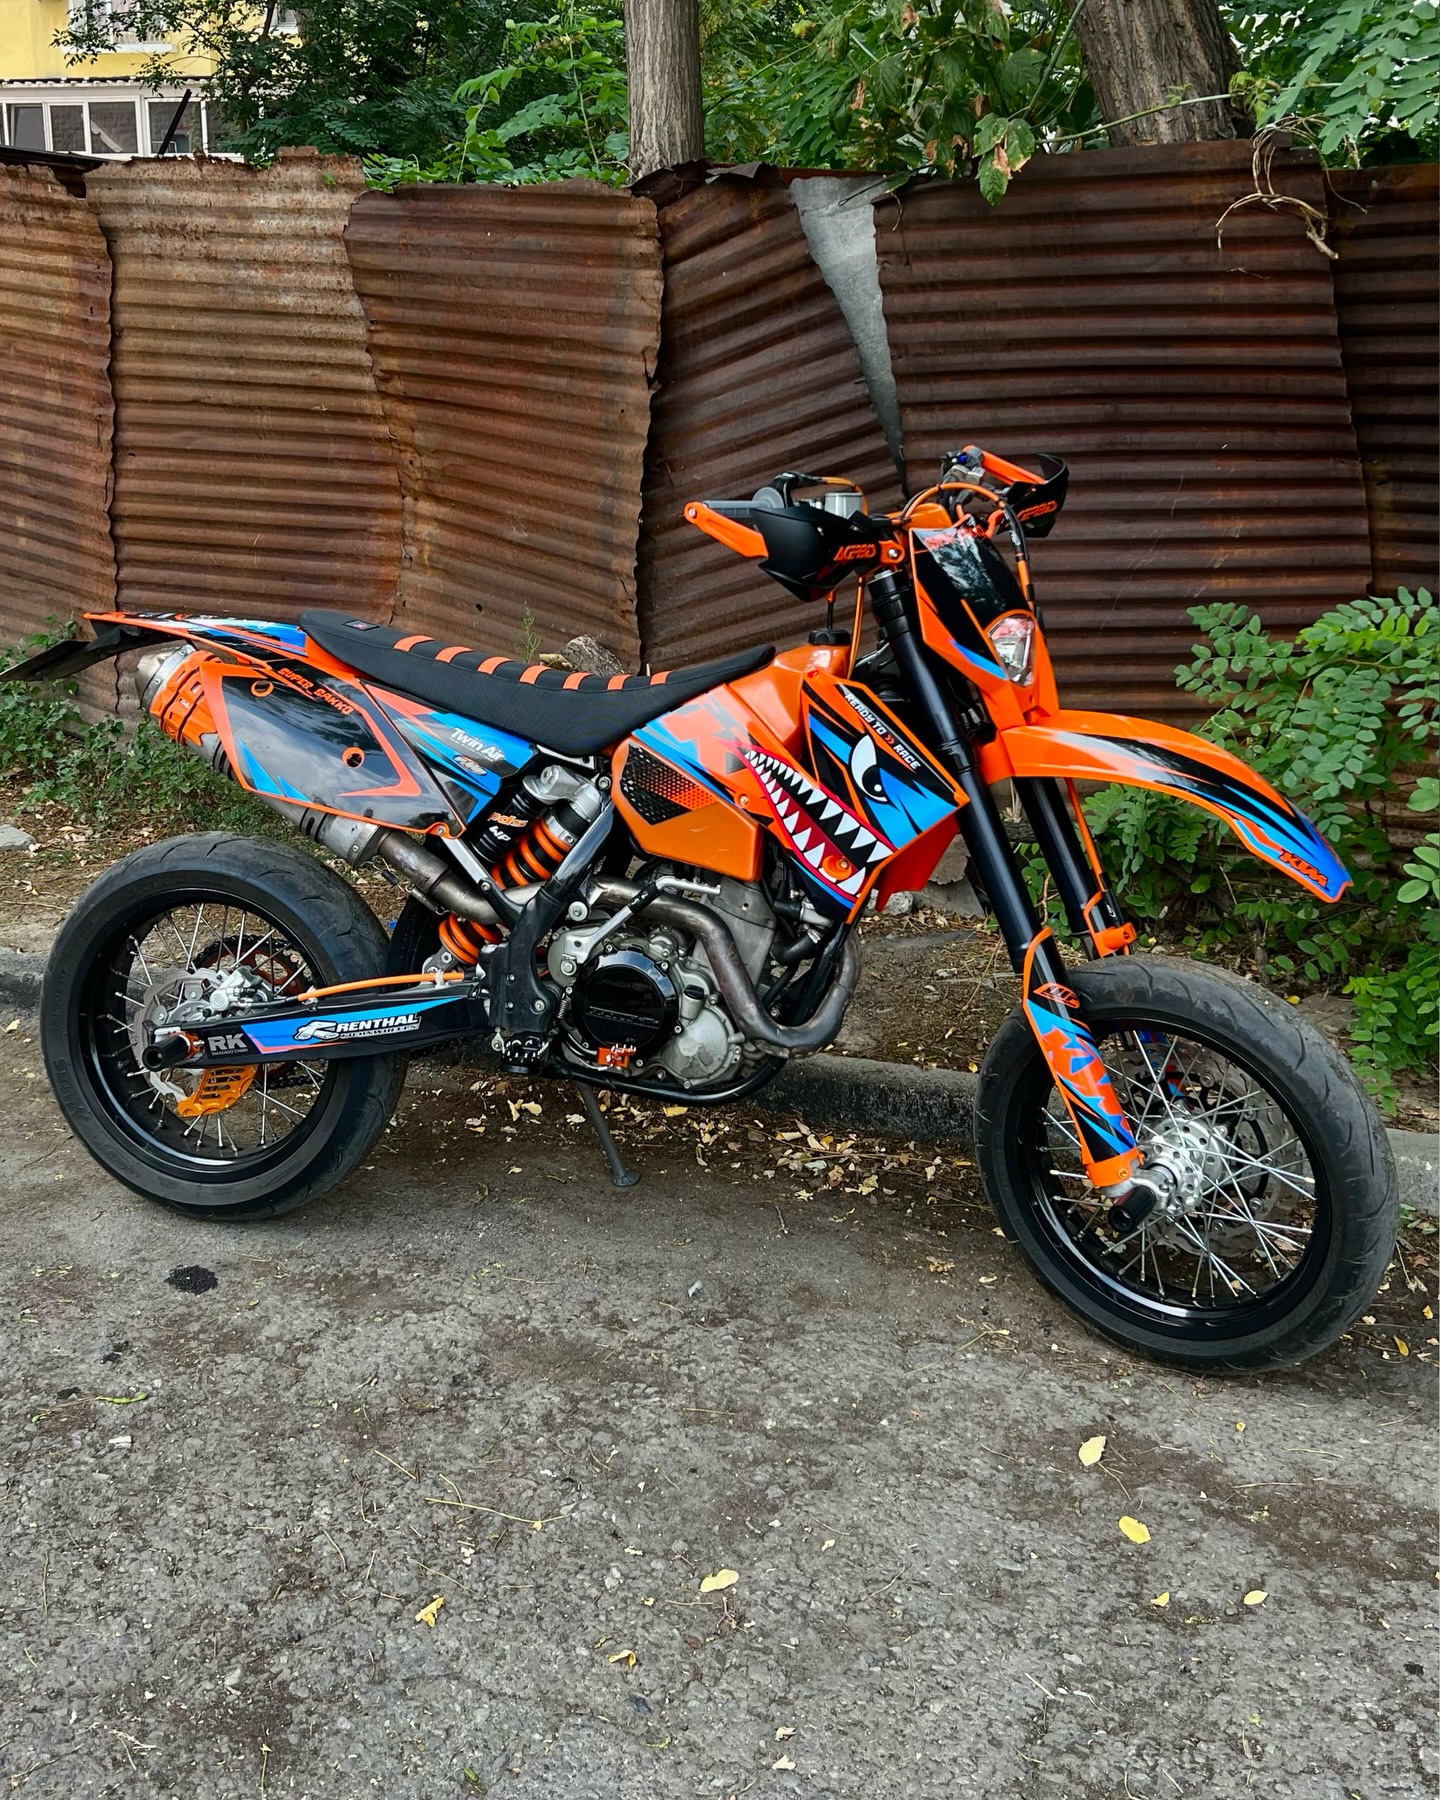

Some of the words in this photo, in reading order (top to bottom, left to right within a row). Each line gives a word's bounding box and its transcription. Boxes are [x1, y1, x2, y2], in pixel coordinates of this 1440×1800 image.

[450, 727, 484, 751] Twin
[480, 746, 505, 760] Air
[845, 693, 875, 723] READY
[872, 721, 888, 735] TO
[893, 744, 921, 769] RACE
[489, 825, 512, 841] WP
[1279, 849, 1329, 888] KTM
[336, 1013, 418, 1032] RENTHAL
[207, 1033, 247, 1051] RK
